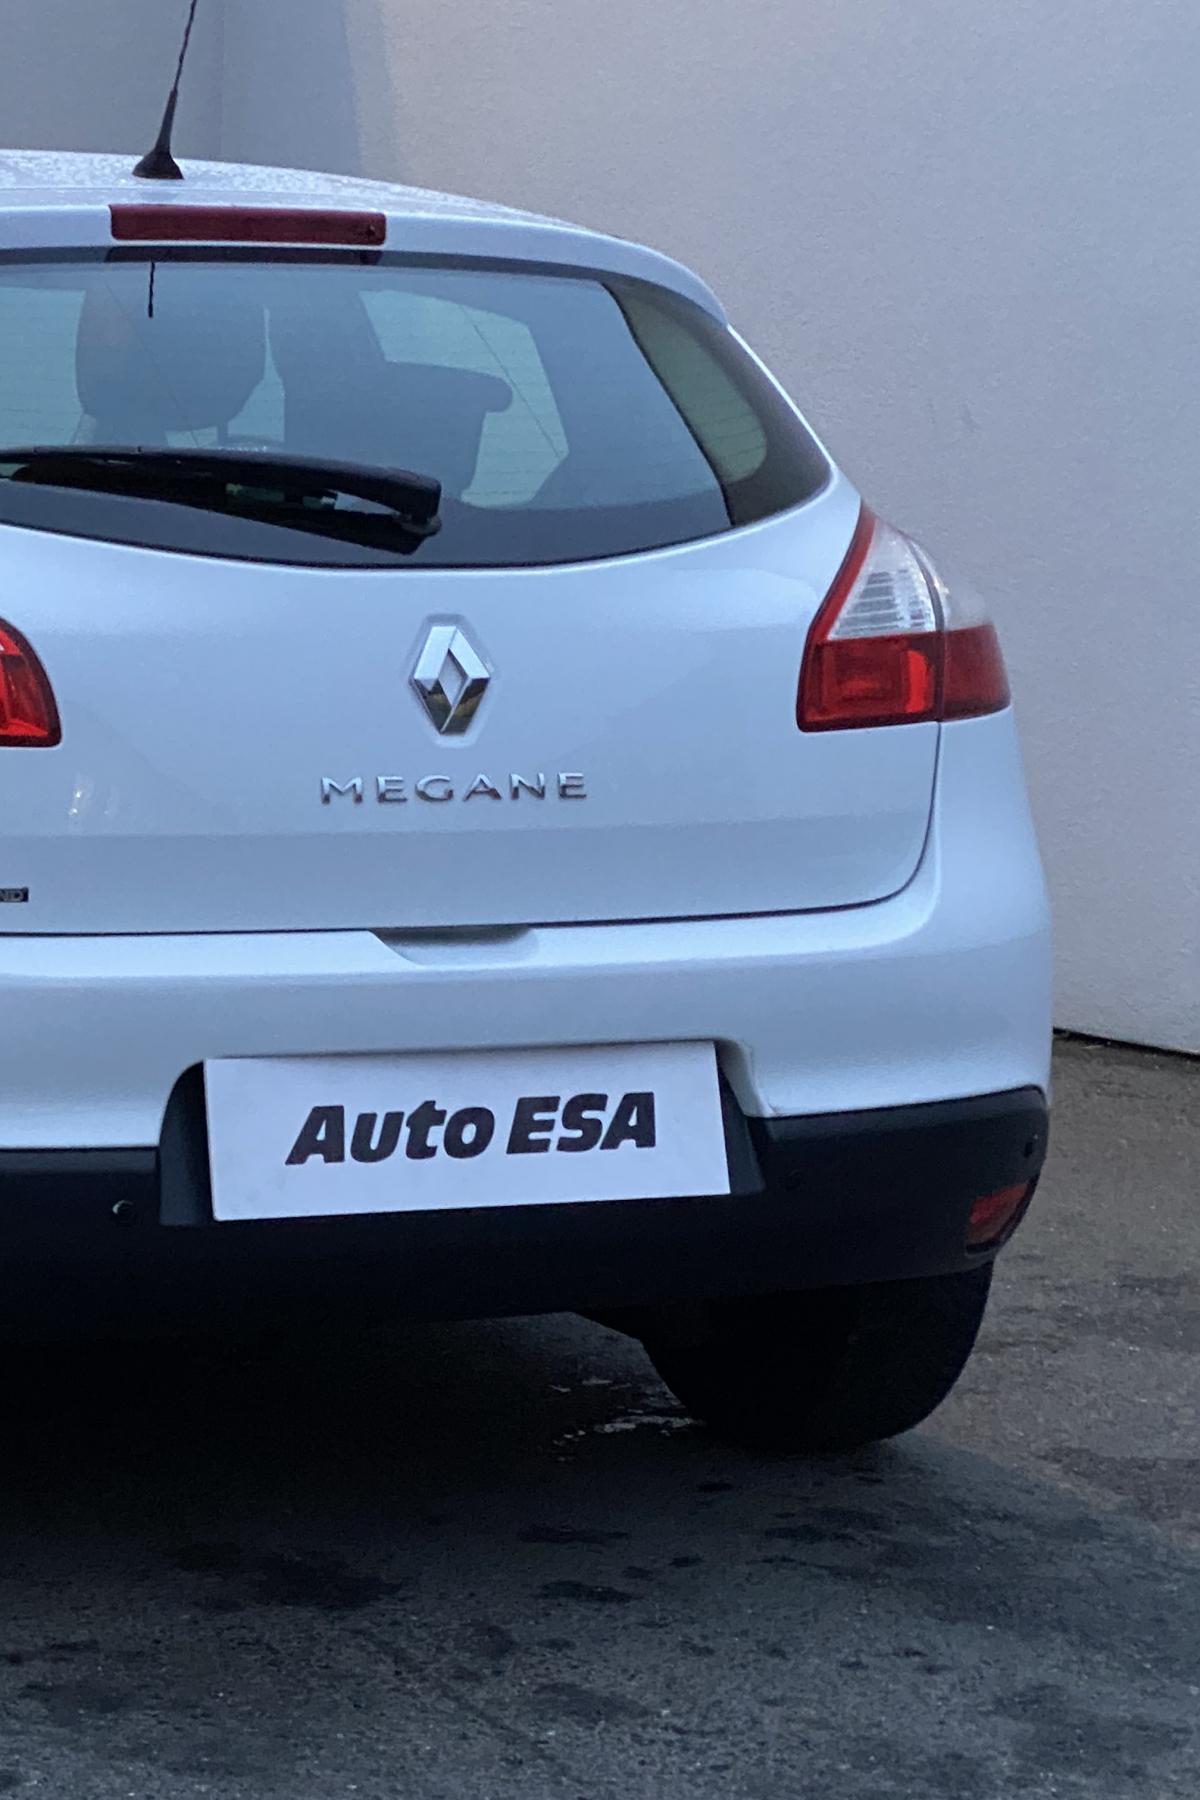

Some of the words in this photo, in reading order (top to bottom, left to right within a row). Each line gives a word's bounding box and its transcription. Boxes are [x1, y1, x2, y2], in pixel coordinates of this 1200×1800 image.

[320, 772, 588, 804] MEGANE
[285, 1100, 495, 1166] Auto
[506, 1091, 656, 1155] ESA
